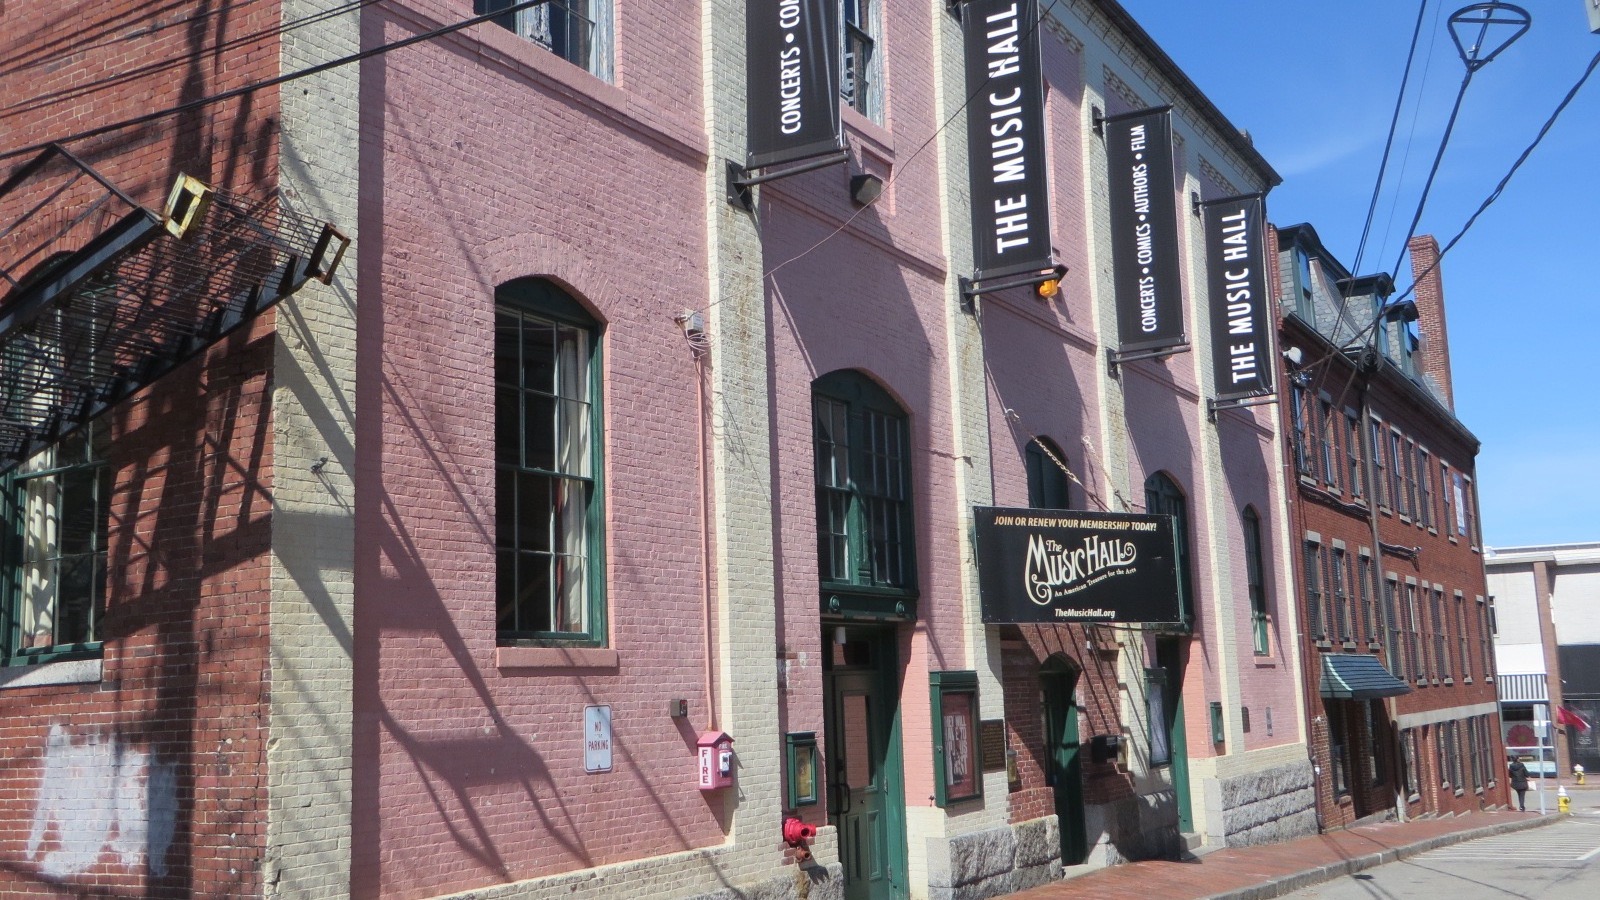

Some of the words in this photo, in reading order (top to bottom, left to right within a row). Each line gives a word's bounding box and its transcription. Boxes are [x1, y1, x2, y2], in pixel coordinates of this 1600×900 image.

[986, 2, 1020, 79] HALL
[780, 46, 802, 134] CONCERTS
[989, 86, 1026, 183] MUSIC
[1130, 124, 1146, 152] FILM
[1131, 163, 1150, 213] AUTHORS
[994, 193, 1029, 254] THE
[1135, 222, 1153, 265] COMICS
[1221, 208, 1248, 262] HALL
[1139, 276, 1157, 333] CONCERTS
[1225, 267, 1253, 335] MUSIC
[1229, 342, 1257, 384] THE
[994, 516, 1013, 526] JOIN
[1015, 517, 1027, 526] OR
[1028, 518, 1057, 528] RENEW
[1058, 519, 1079, 528] YOUR
[1080, 520, 1130, 530] MEMBERSHIP
[1131, 521, 1157, 531] TODAY!
[1045, 540, 1063, 552] The
[1083, 535, 1136, 575] HALL
[1064, 583, 1088, 595] American
[1087, 573, 1108, 586] Treasure
[1125, 567, 1137, 575] Arts
[1054, 608, 1116, 619] TheMusicHall.org
[588, 739, 609, 751] PARKING
[594, 721, 602, 732] NO
